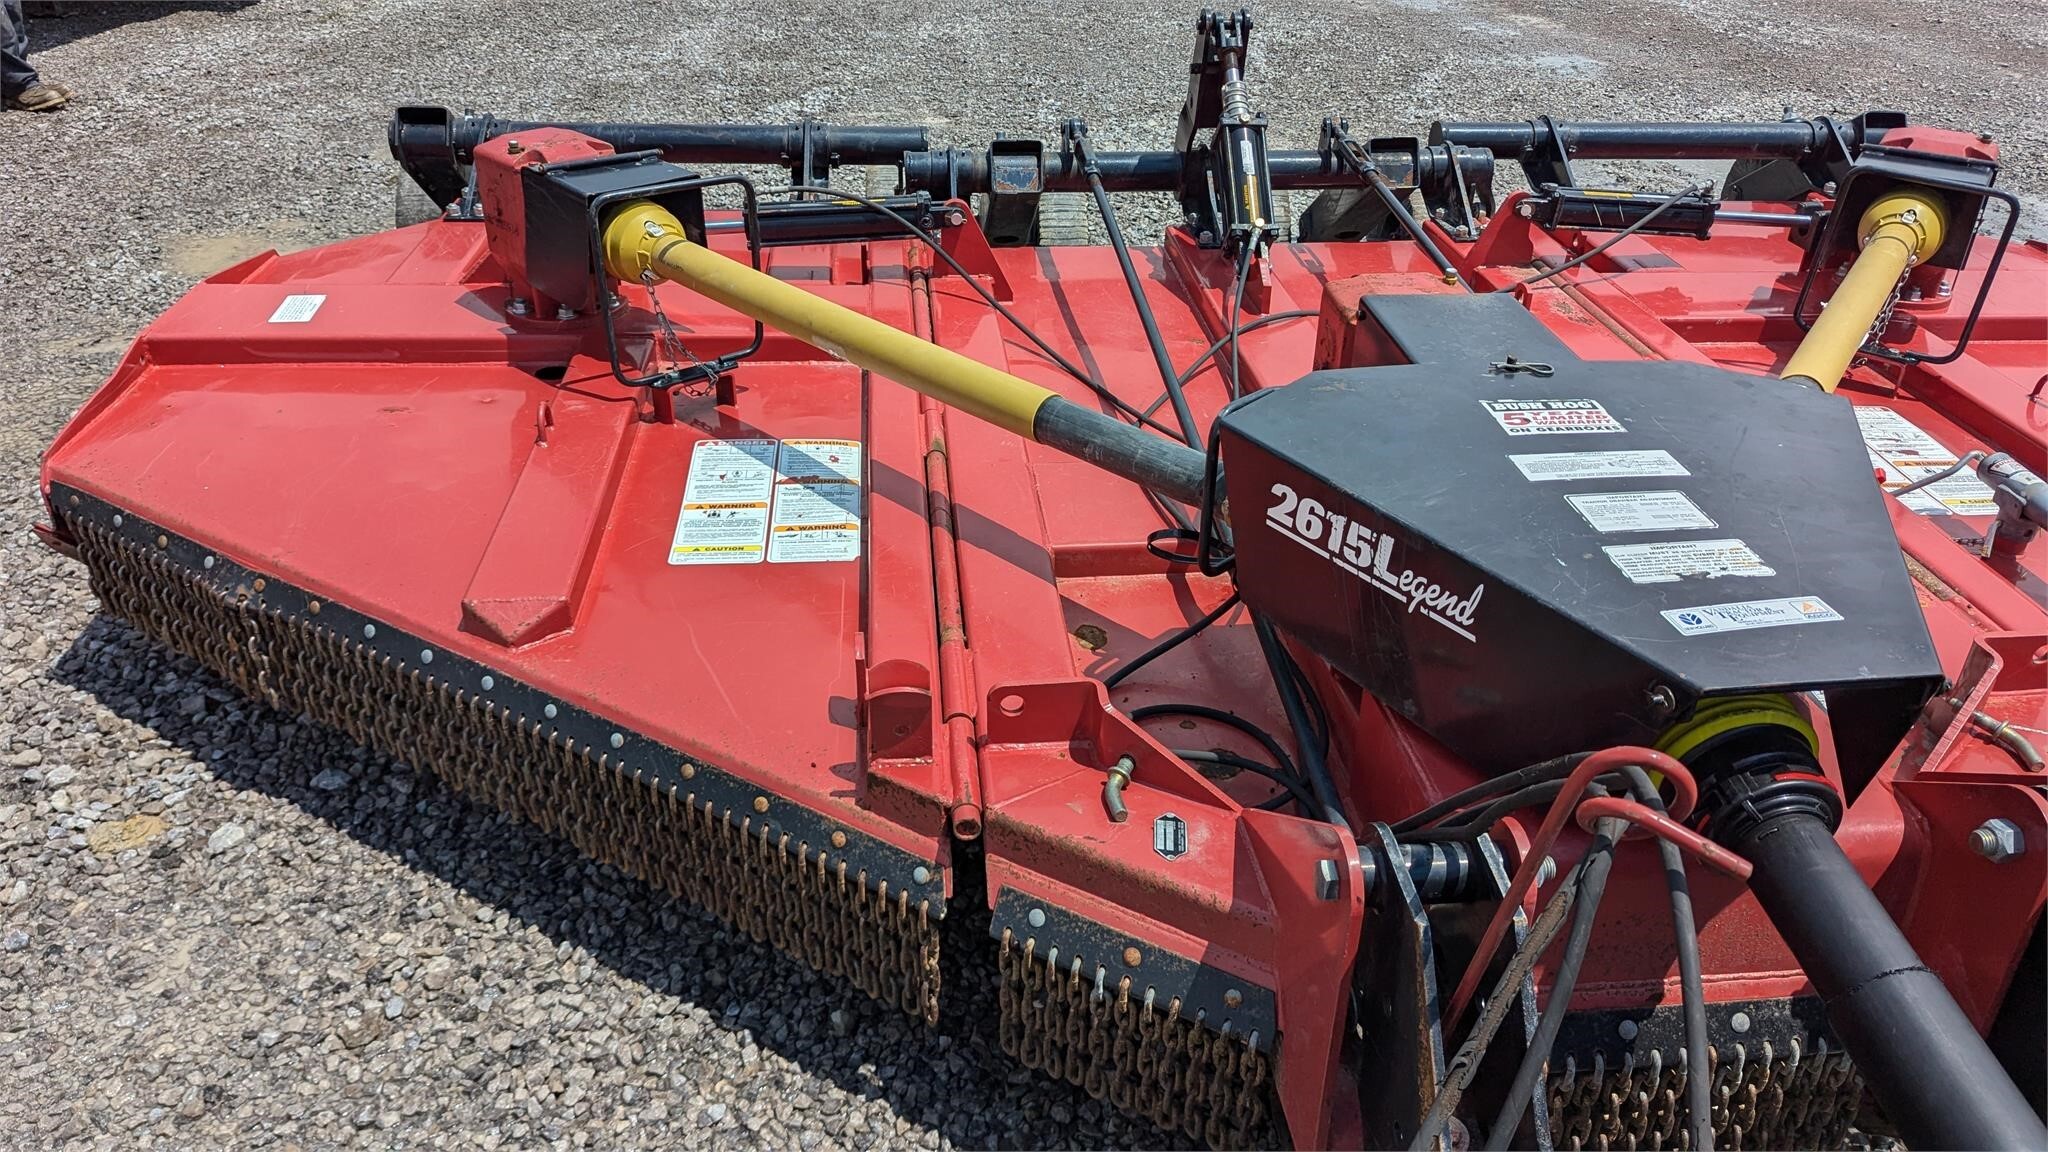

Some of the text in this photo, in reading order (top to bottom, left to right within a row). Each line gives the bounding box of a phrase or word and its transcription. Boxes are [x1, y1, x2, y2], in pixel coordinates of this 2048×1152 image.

[1491, 400, 1594, 411] BUSH HOG
[1503, 412, 1531, 426] 5
[1536, 424, 1622, 433] GEARBOXES
[1728, 609, 1786, 622] EQUIPMENT
